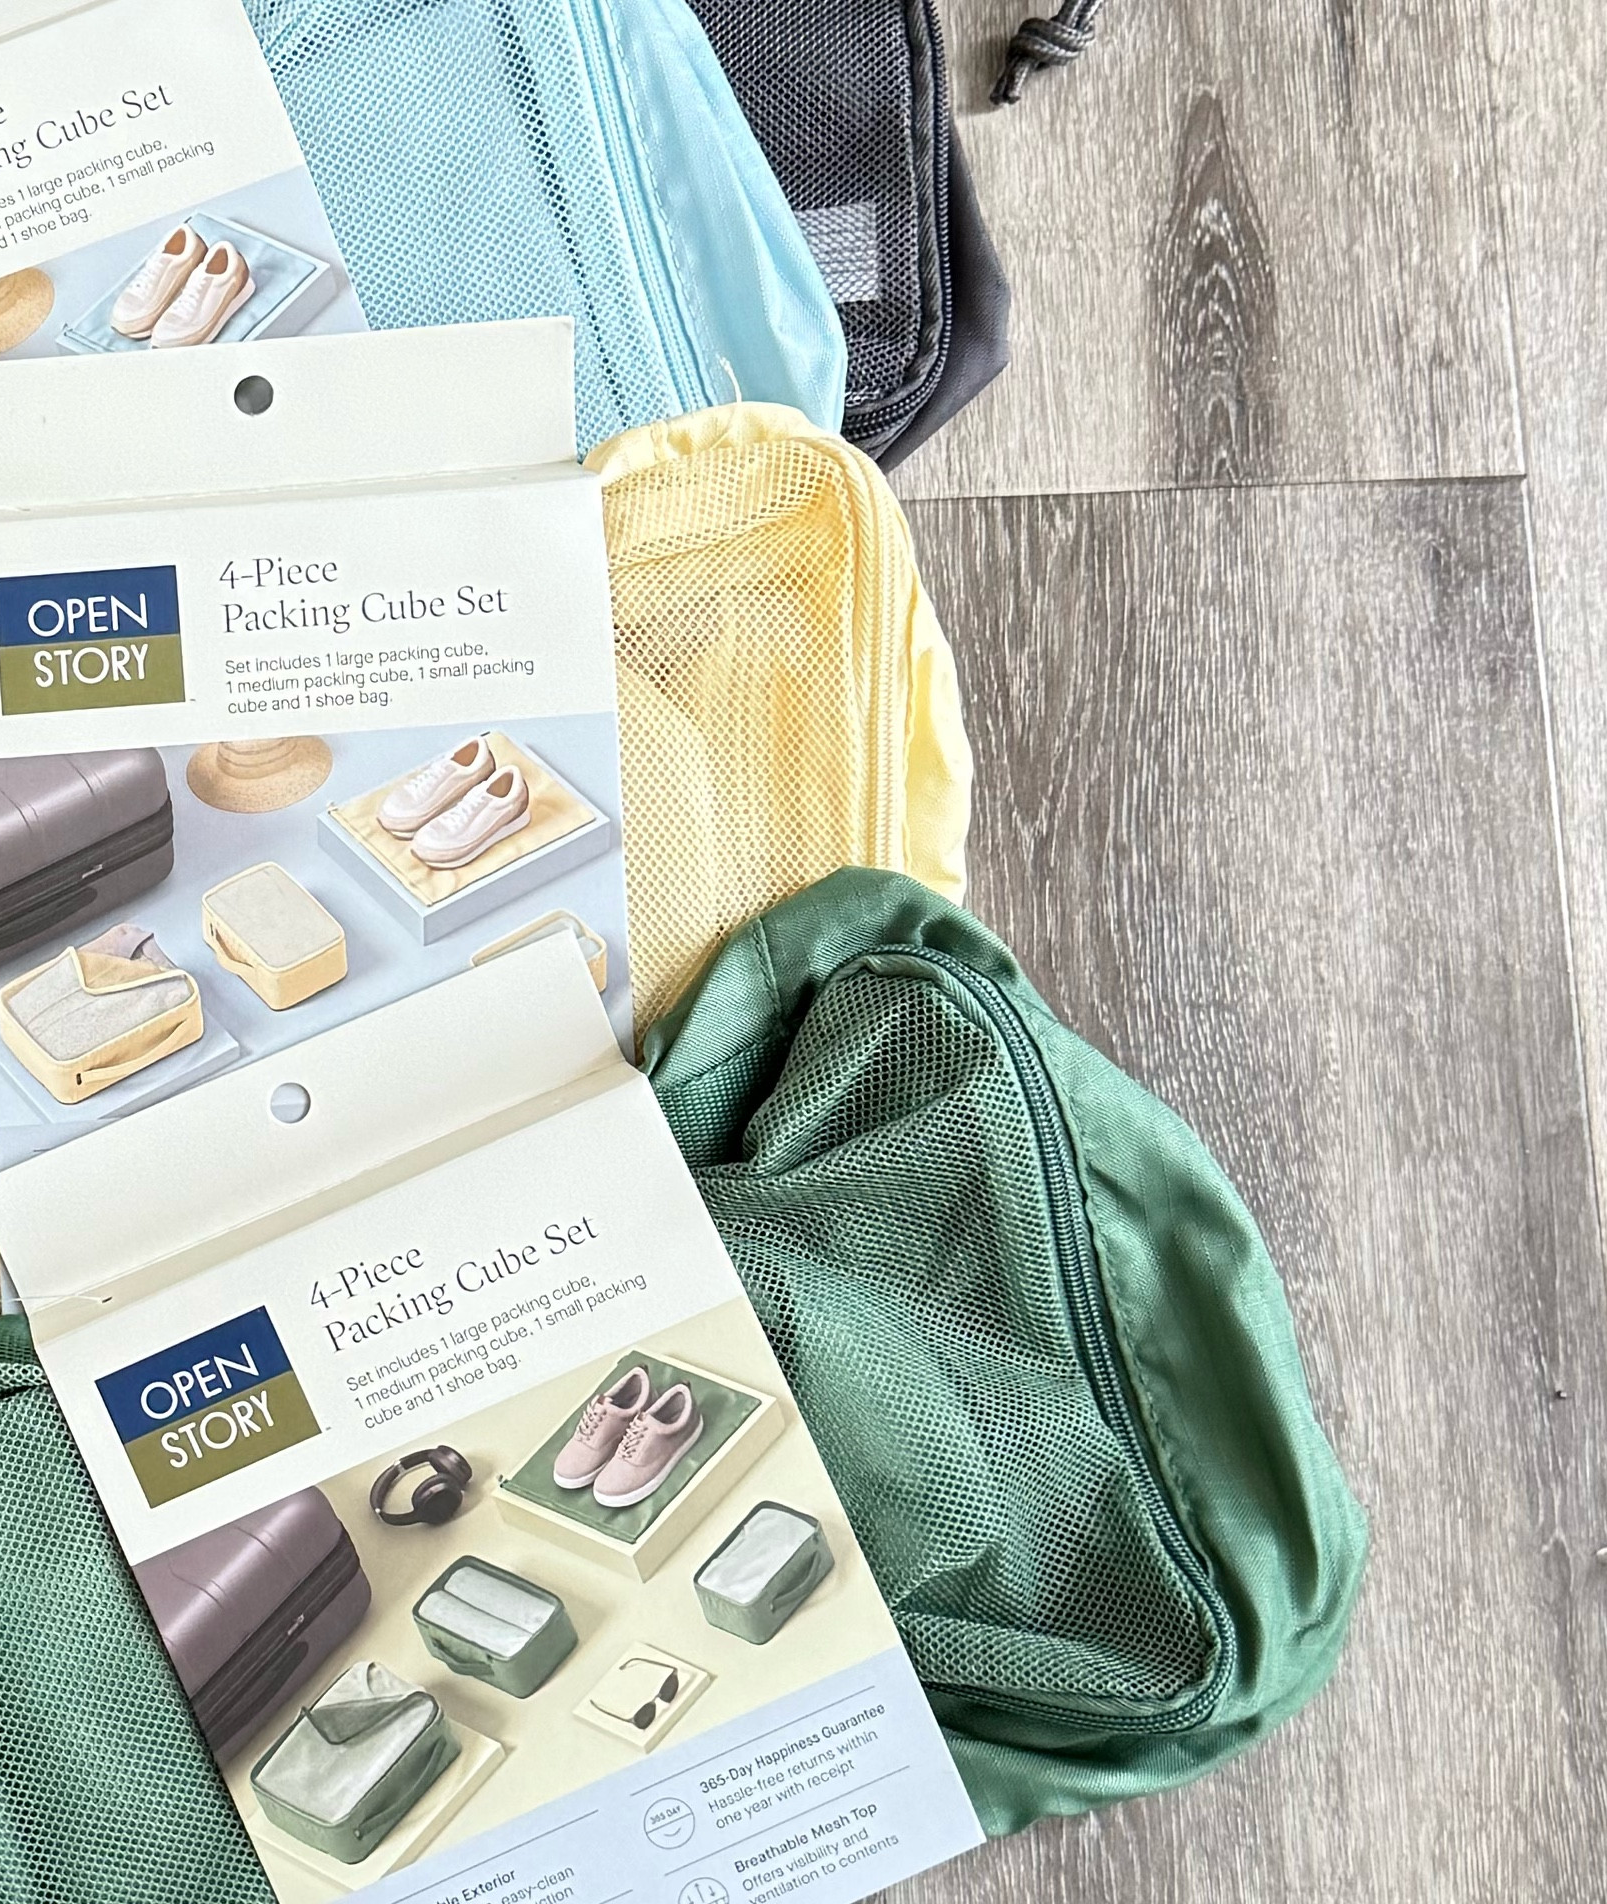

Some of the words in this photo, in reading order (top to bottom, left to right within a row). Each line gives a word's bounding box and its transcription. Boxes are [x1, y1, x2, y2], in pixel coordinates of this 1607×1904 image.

[36, 108, 116, 149] Cube
[121, 85, 173, 118] Set
[4, 198, 62, 230] packing
[63, 183, 105, 204] cube,
[107, 175, 115, 187] 1
[117, 160, 154, 184] small
[157, 141, 214, 173] packing
[17, 189, 25, 200] 1
[26, 177, 62, 198] large
[66, 154, 124, 187] packing
[125, 140, 167, 161] cube,
[10, 232, 17, 244] 1
[20, 220, 56, 240] shoe
[58, 208, 92, 226] bag.
[219, 556, 337, 589] 4-Piece
[28, 593, 148, 637] OPEN
[221, 598, 350, 634] Packing
[361, 590, 445, 622] Cube
[457, 585, 508, 615] Set
[34, 644, 148, 687] STORY
[225, 660, 251, 674] Set
[255, 655, 321, 672] includes
[325, 653, 331, 667] 1
[336, 651, 373, 668] large
[378, 646, 439, 666] packing
[444, 642, 488, 657] cube,
[225, 680, 232, 693] 1
[237, 677, 299, 693] medium
[304, 671, 365, 692] packing
[369, 668, 413, 683] cube,
[418, 666, 424, 679] 1
[429, 662, 467, 679] small
[473, 658, 534, 679] packing
[227, 698, 267, 714] cube
[271, 695, 300, 710] and
[305, 695, 310, 708] 1
[315, 692, 354, 707] shoe
[359, 690, 392, 706] bag.
[310, 1248, 424, 1308] 4-Piece
[322, 1283, 453, 1353] Packing
[456, 1245, 540, 1292] Cube
[544, 1216, 599, 1255] Set
[346, 1371, 374, 1391] Set
[374, 1343, 439, 1379] includes
[439, 1336, 448, 1349] 1
[449, 1321, 488, 1345] large
[490, 1294, 551, 1332] packing
[552, 1276, 596, 1300] cube,
[354, 1397, 363, 1409] 1
[365, 1372, 426, 1406] medium
[428, 1344, 489, 1382] packing
[489, 1326, 533, 1350] cube,
[534, 1317, 542, 1330] 1
[545, 1298, 584, 1325] small
[586, 1274, 647, 1312] packing
[141, 1343, 259, 1419] OPEN
[364, 1404, 402, 1428] cube
[405, 1387, 434, 1410] and
[435, 1384, 444, 1396] 1
[446, 1368, 484, 1392] shoe
[485, 1354, 521, 1374] bag.
[161, 1390, 274, 1468] STORY
[699, 1763, 752, 1793] 365-Day
[754, 1733, 820, 1769] Happiness
[821, 1704, 885, 1738] Guarantee
[707, 1772, 784, 1813] Hassle-free
[787, 1749, 835, 1778] returns
[836, 1731, 878, 1755] within
[716, 1810, 742, 1829] one
[743, 1796, 772, 1820] year
[775, 1782, 804, 1802] with
[807, 1759, 855, 1788] receipt
[734, 1834, 808, 1873] Breathable
[810, 1815, 850, 1839] Mesh
[849, 1804, 877, 1820] Top
[742, 1867, 784, 1891] Offers
[785, 1842, 838, 1872] visibility
[842, 1826, 869, 1848] and
[821, 1862, 836, 1875] to
[838, 1835, 899, 1868] contents
[461, 1870, 515, 1901] Exterior
